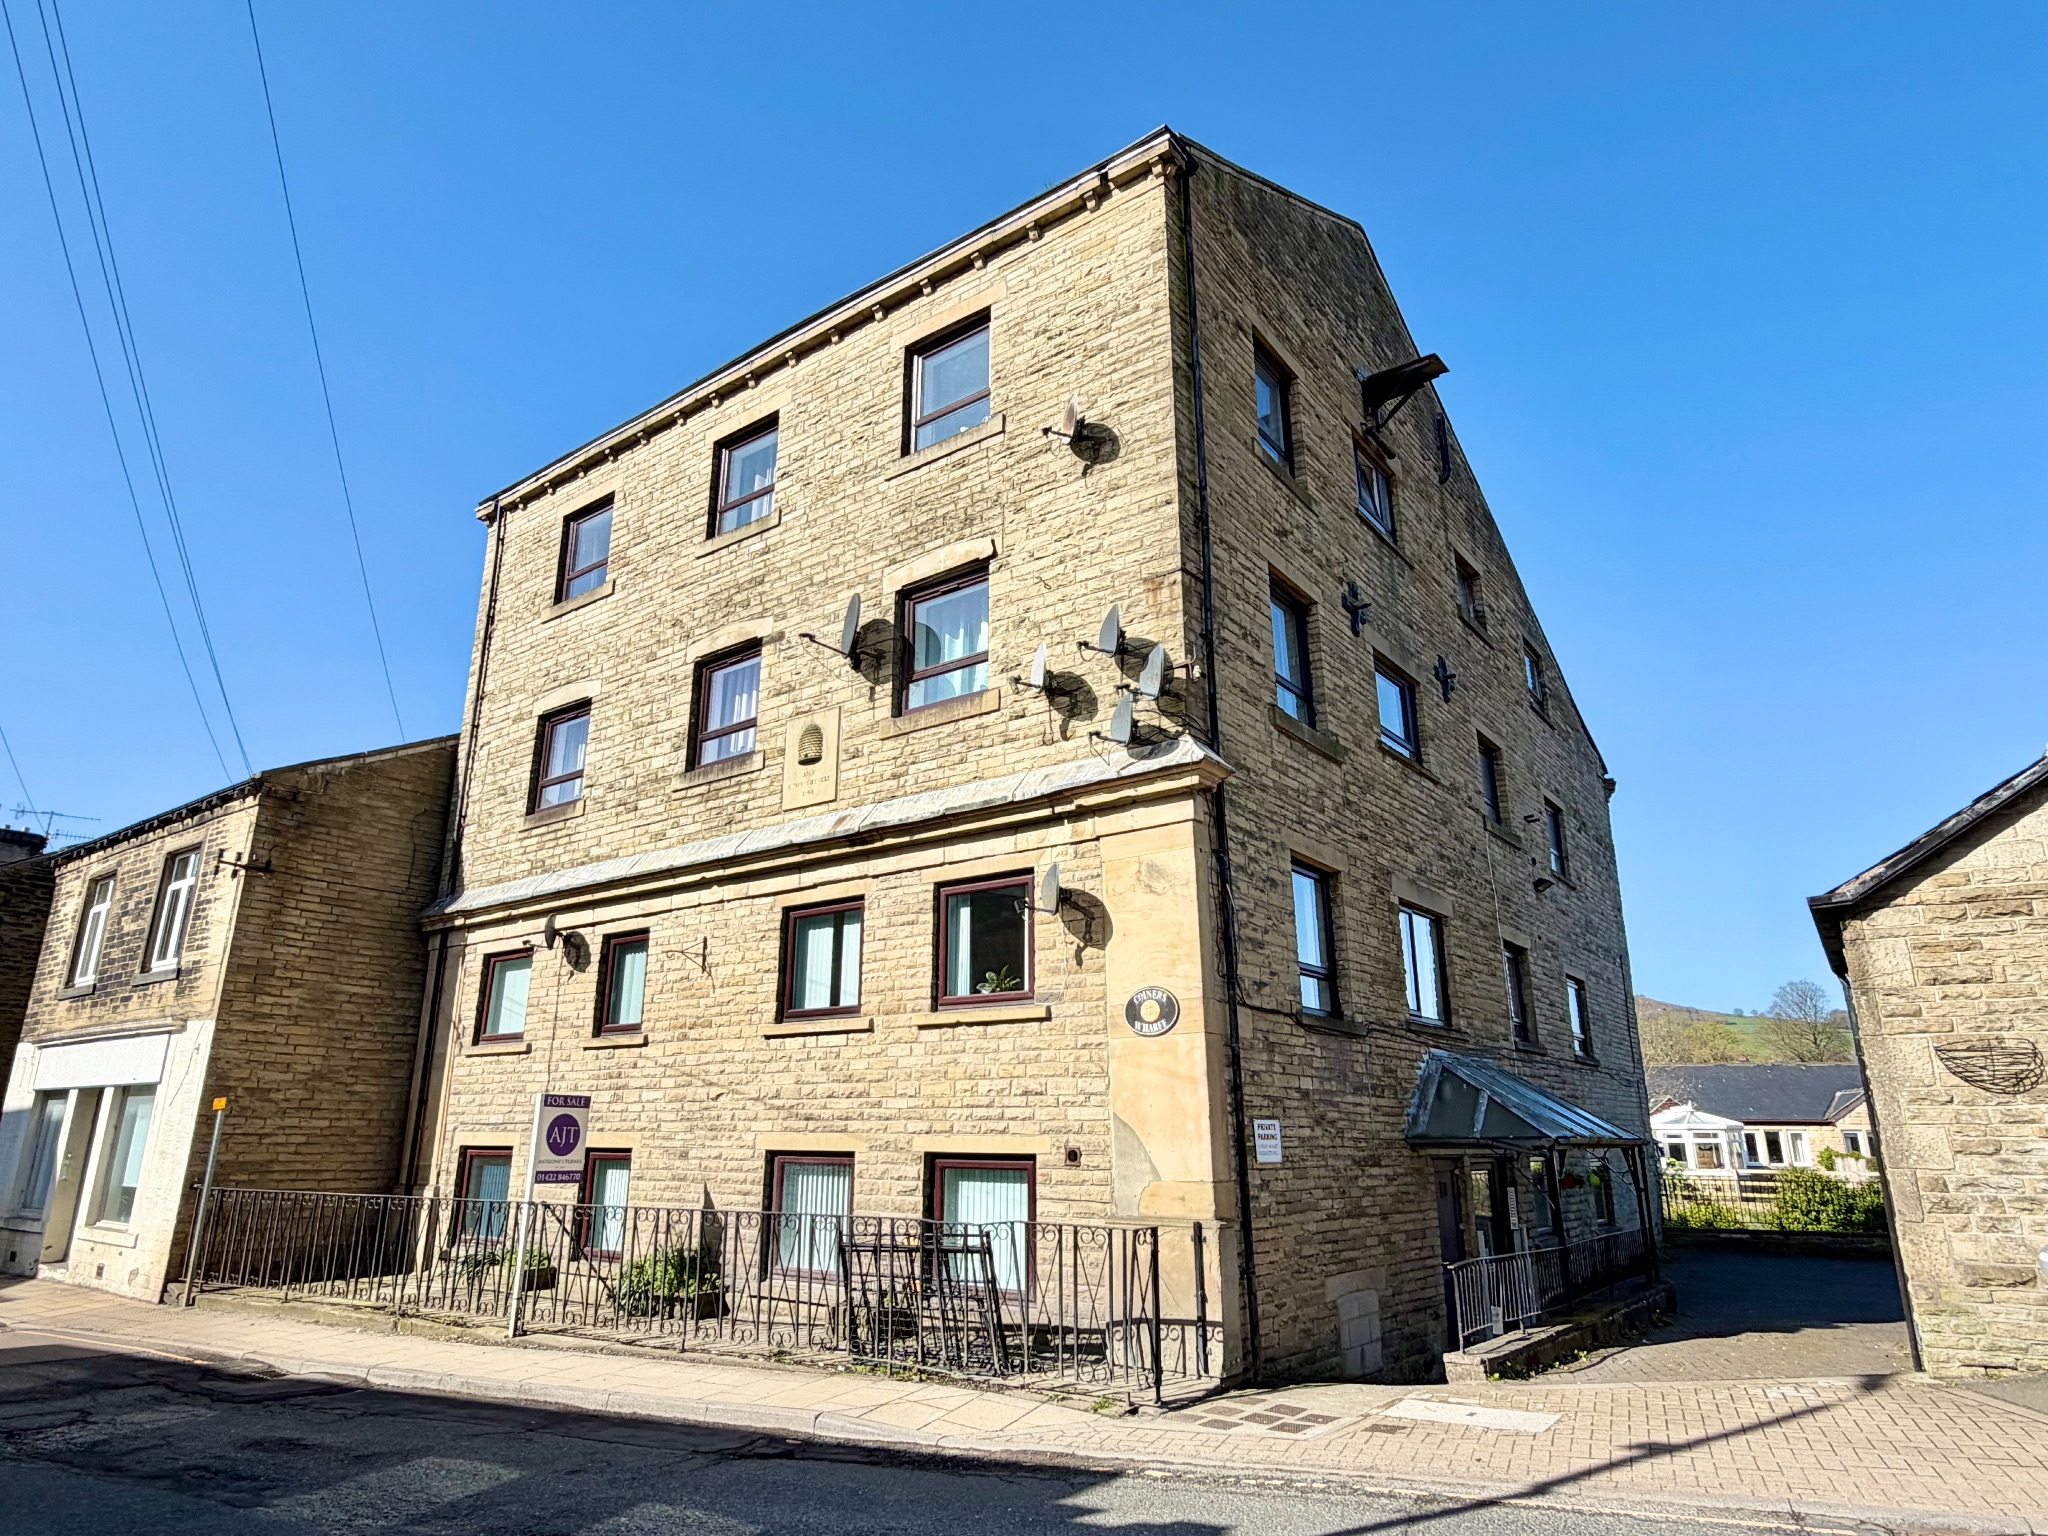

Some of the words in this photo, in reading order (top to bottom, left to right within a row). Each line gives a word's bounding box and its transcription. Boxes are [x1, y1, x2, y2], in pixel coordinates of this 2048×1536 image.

[1133, 989, 1168, 1004] COINERS
[547, 1096, 565, 1106] FOR
[566, 1096, 586, 1107] SALE
[1257, 1123, 1277, 1131] PRIVATE
[549, 1126, 579, 1147] AJT
[1257, 1133, 1278, 1141] PARKING
[536, 1173, 557, 1181] 01422
[557, 1173, 581, 1181] 846770
